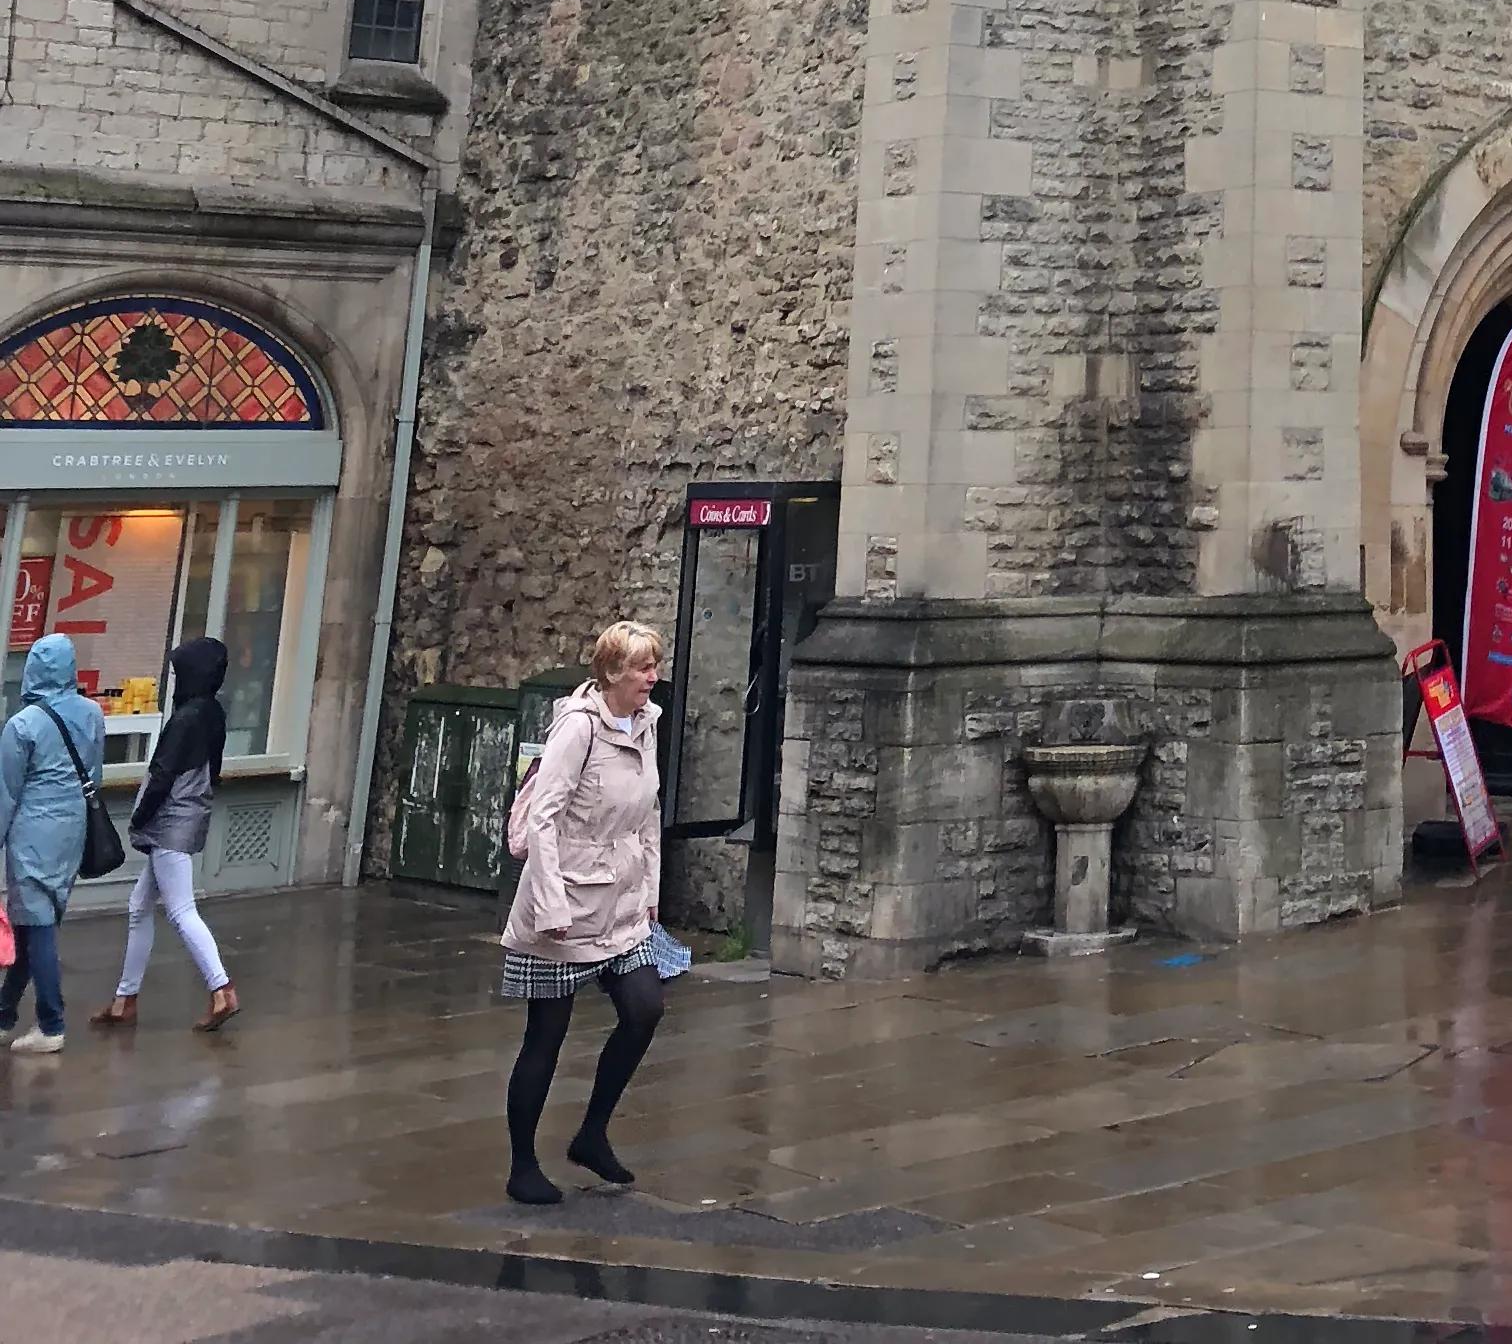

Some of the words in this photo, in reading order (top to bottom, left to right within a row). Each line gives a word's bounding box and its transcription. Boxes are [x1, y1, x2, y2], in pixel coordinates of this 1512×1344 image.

[52, 454, 144, 467] CRABTREE
[147, 453, 160, 467] &
[164, 454, 228, 466] EVELYN
[700, 504, 722, 523] Coins
[723, 506, 731, 523] &
[732, 504, 757, 522] Cards
[788, 563, 821, 583] BT
